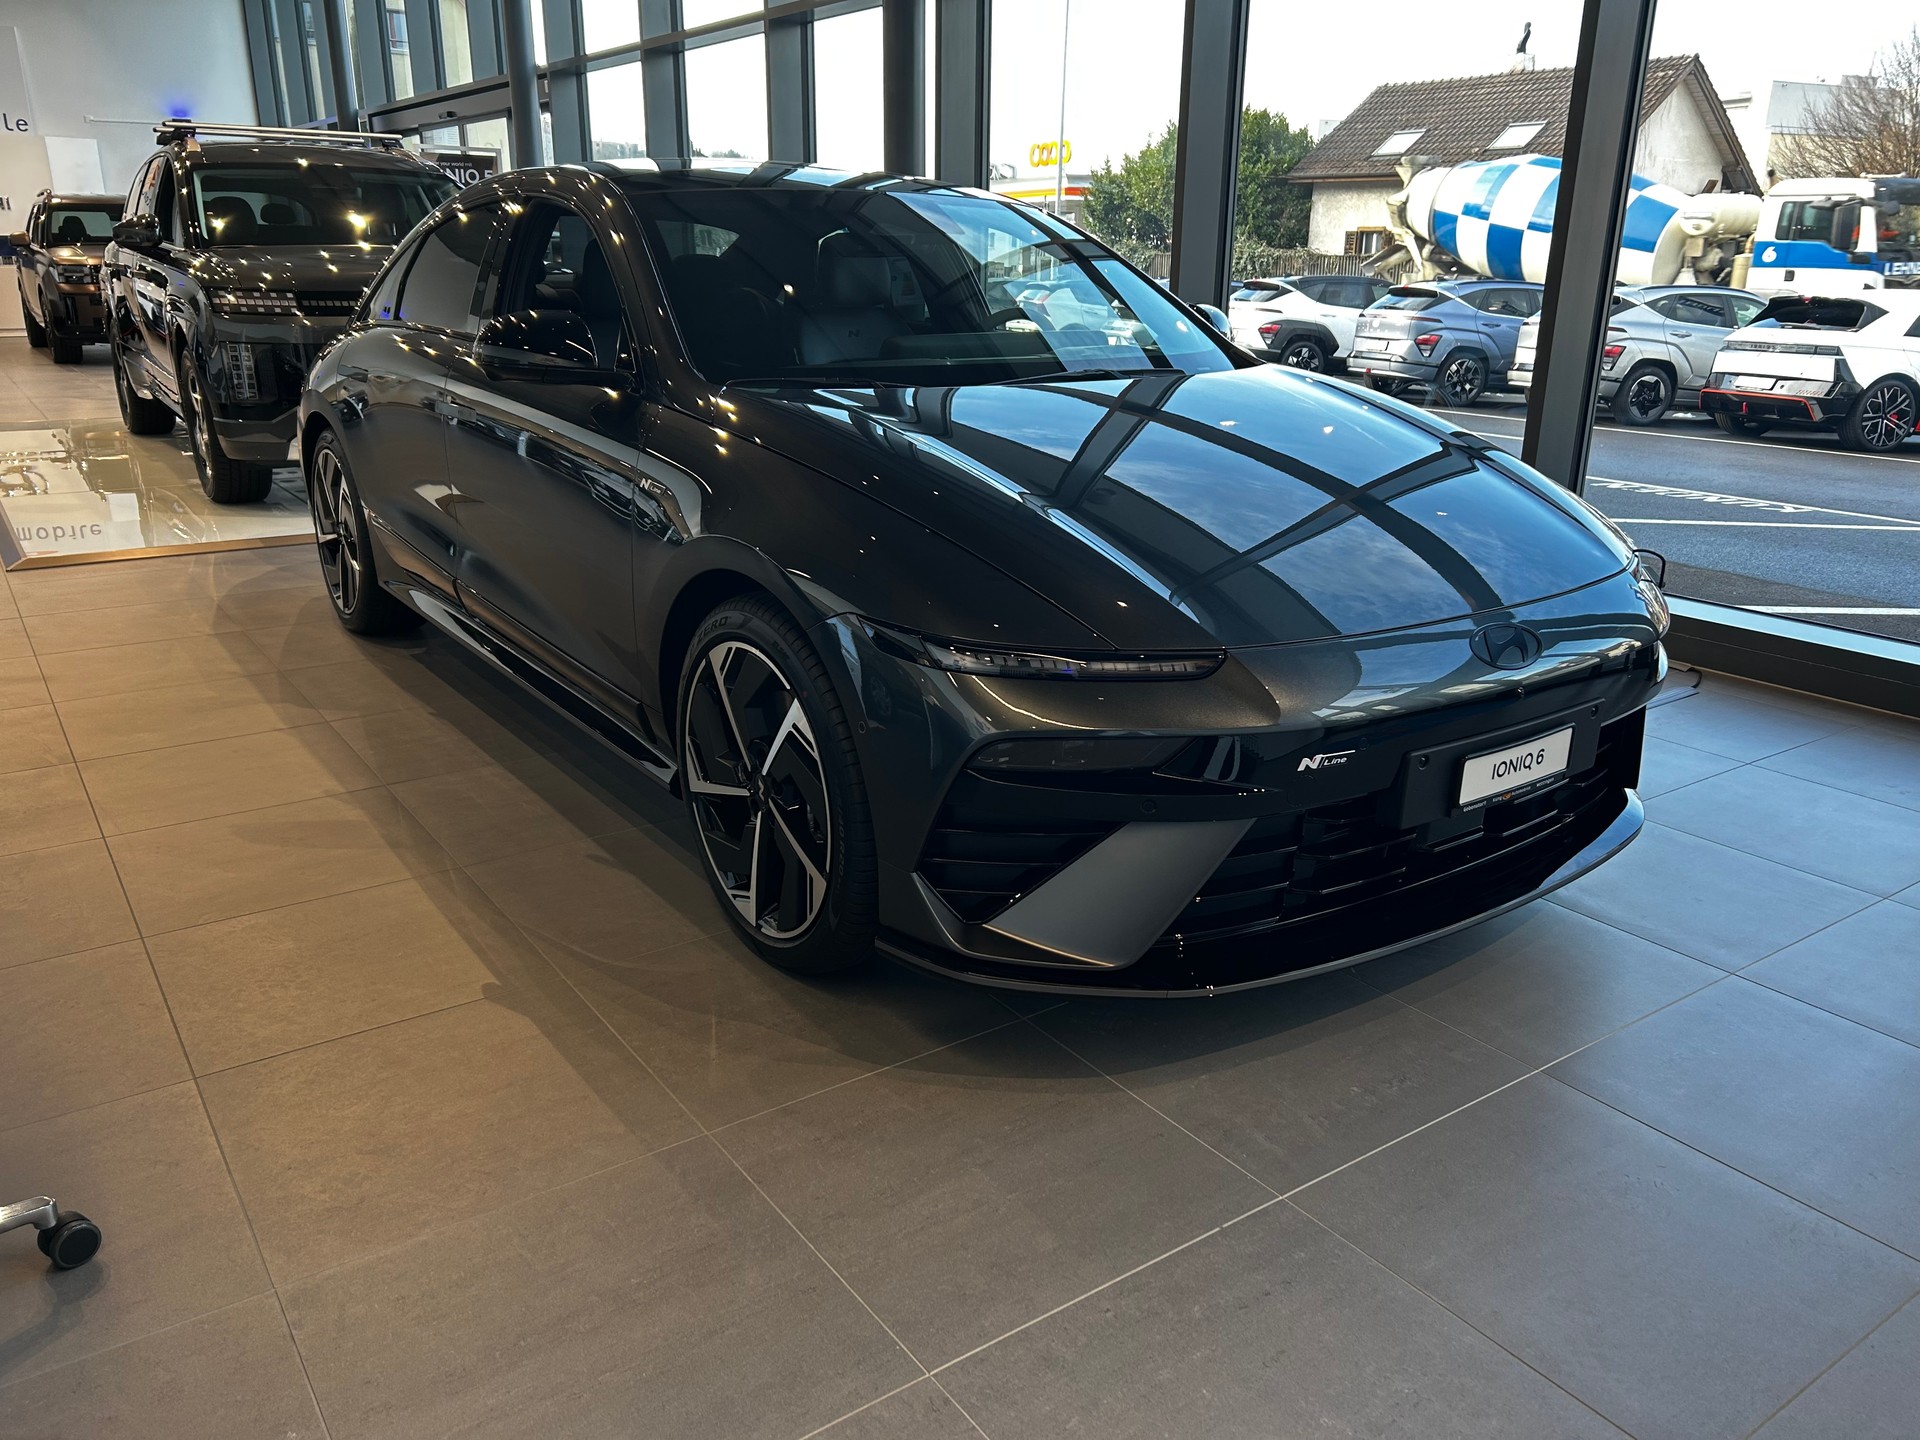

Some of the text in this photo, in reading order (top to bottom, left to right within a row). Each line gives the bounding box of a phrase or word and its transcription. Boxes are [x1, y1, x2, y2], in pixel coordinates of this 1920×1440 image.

[1762, 246, 1777, 263] 6
[1324, 757, 1347, 766] Line
[1491, 748, 1545, 780] IONIQ 6
